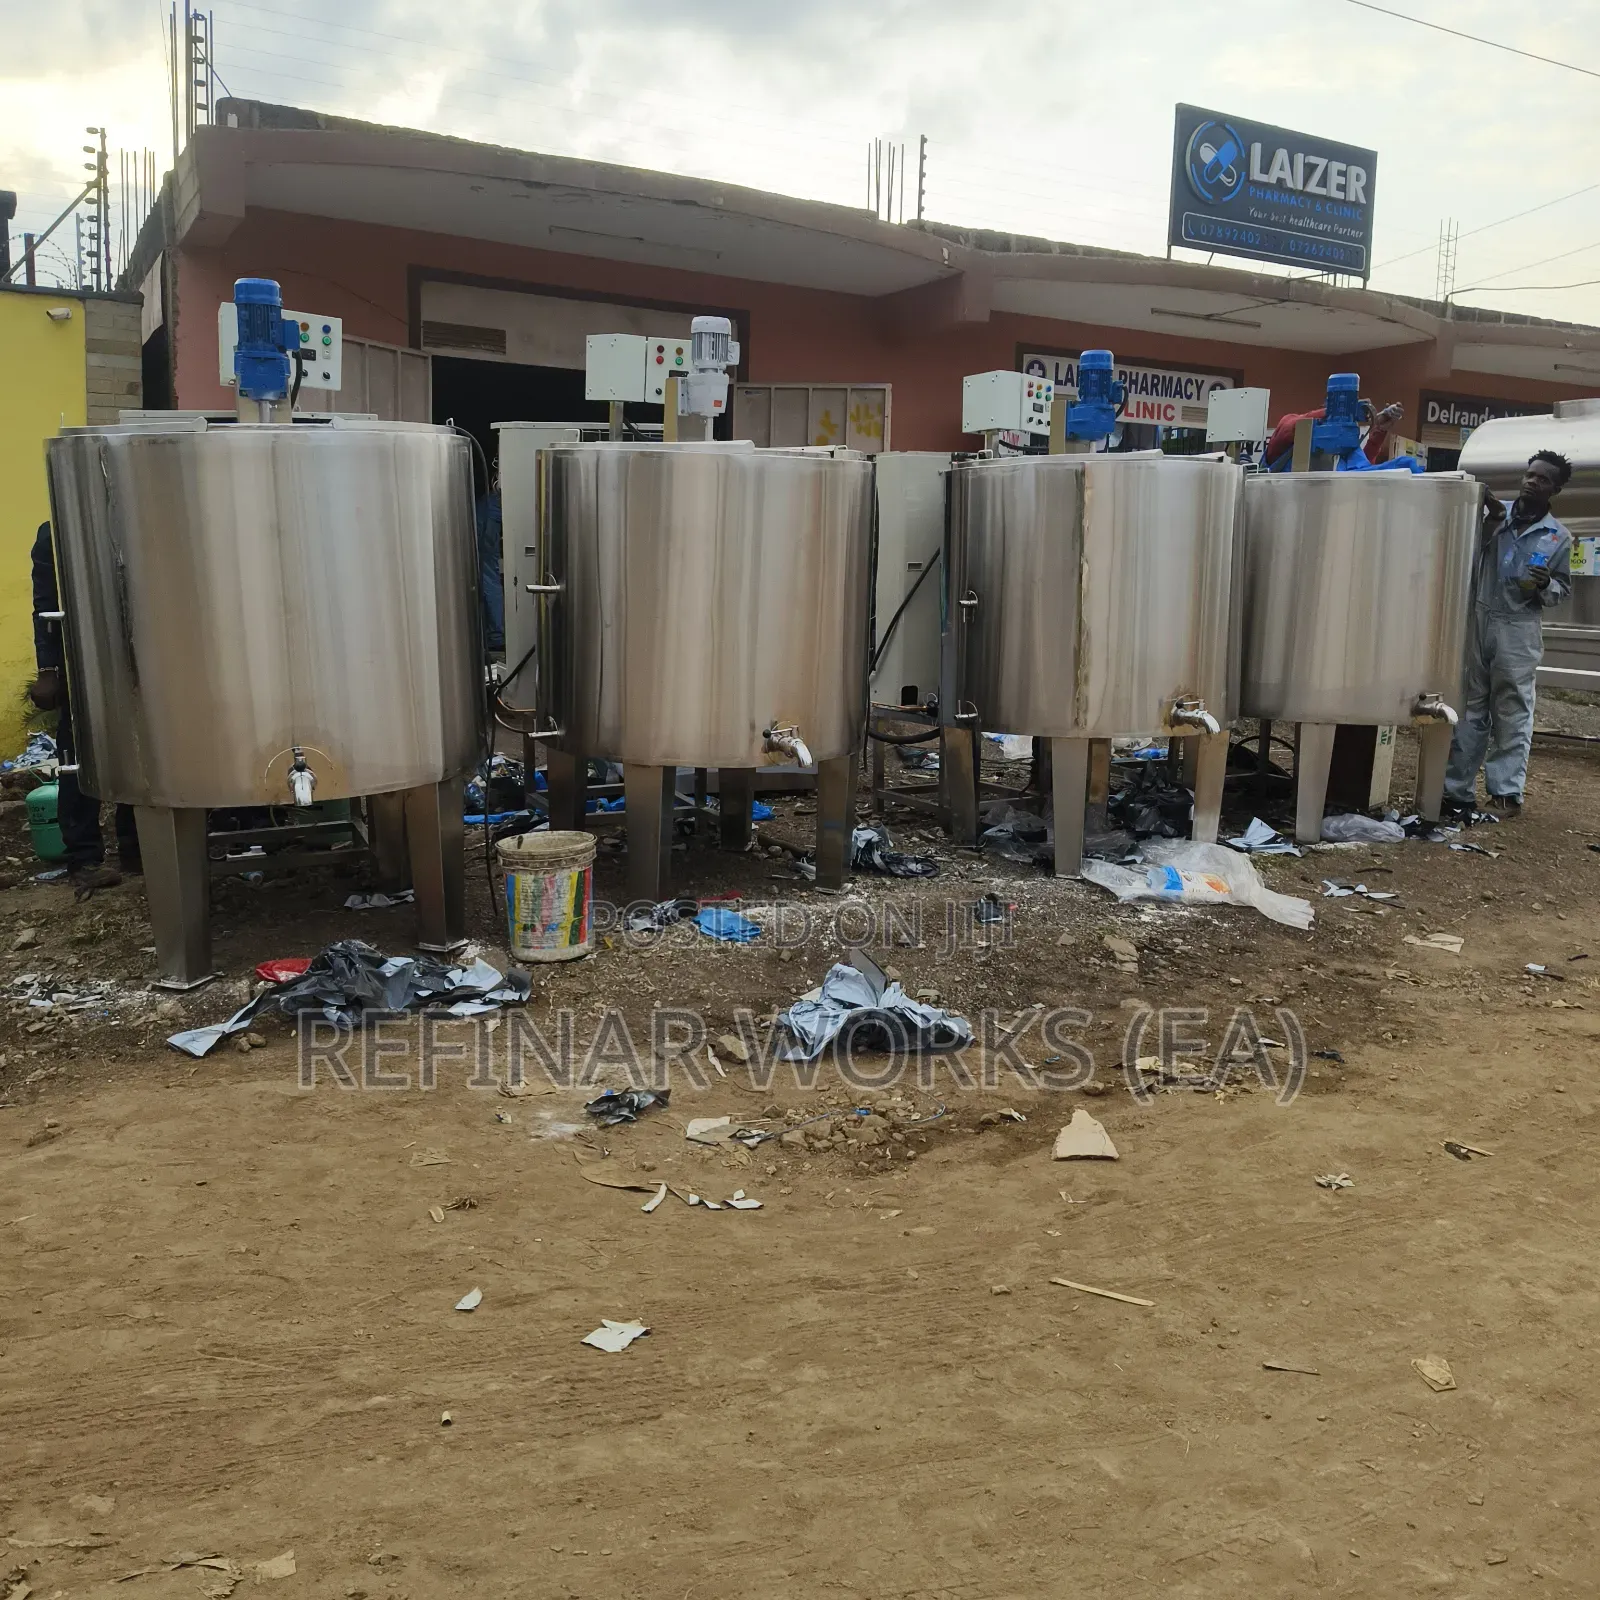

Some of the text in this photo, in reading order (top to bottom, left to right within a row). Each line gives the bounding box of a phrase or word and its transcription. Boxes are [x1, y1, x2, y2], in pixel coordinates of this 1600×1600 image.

[1249, 142, 1367, 205] LAIZER
[1249, 186, 1364, 221] PHARMACY & CLINIC
[1248, 206, 1267, 219] Your
[1289, 214, 1332, 232] healthcare
[1333, 223, 1364, 239] Partner
[1118, 370, 1206, 401] PHARMACY
[1123, 400, 1176, 422] LINIC
